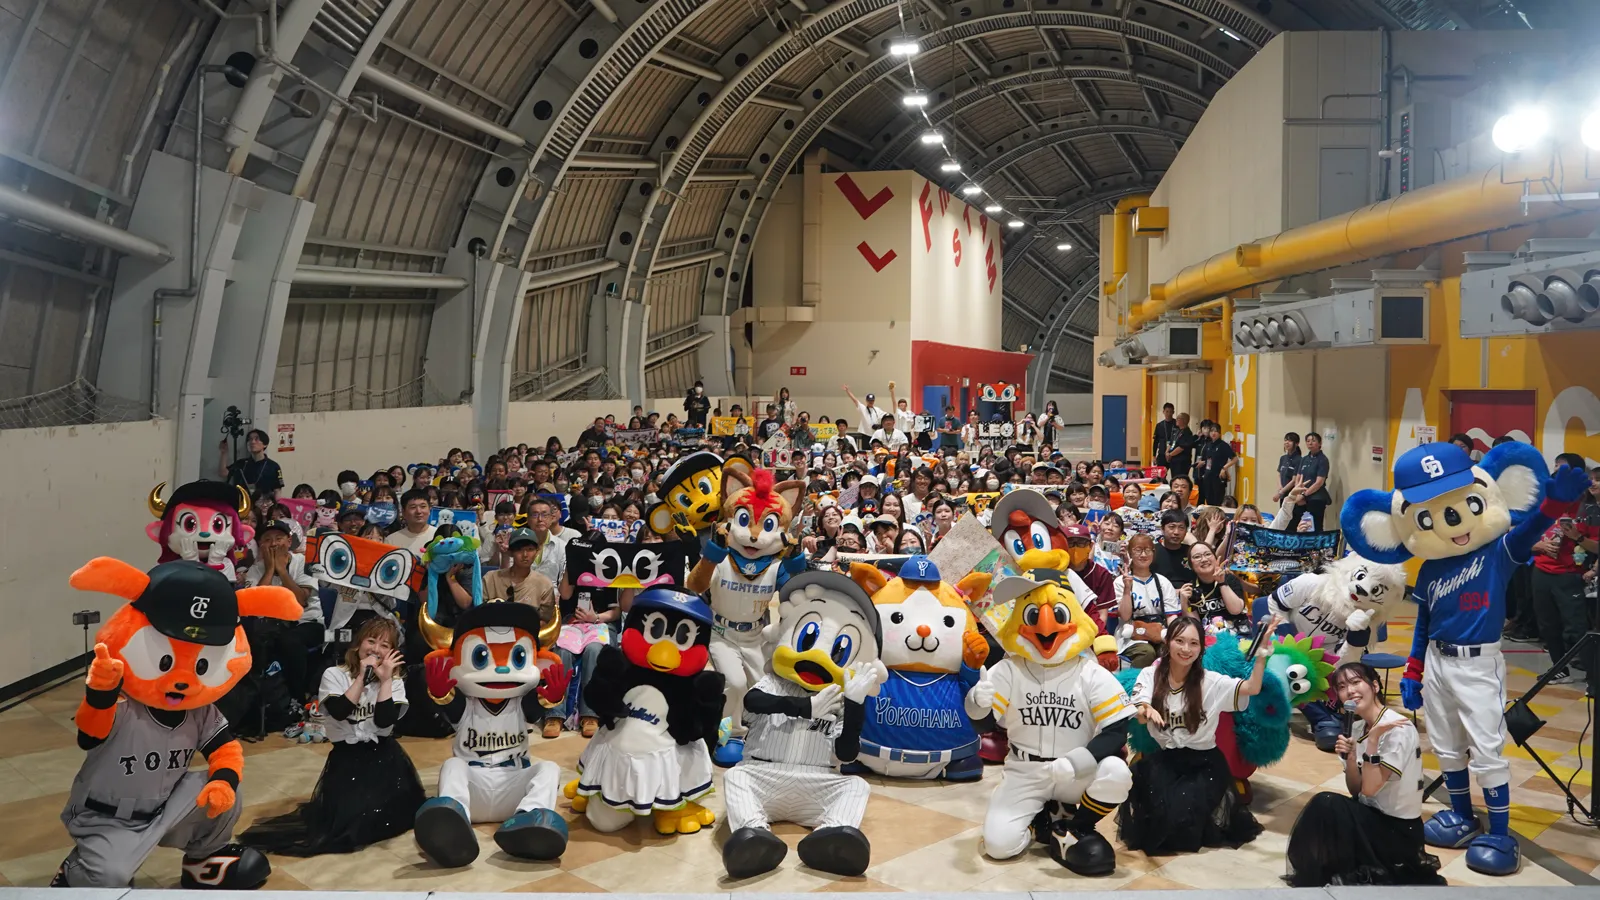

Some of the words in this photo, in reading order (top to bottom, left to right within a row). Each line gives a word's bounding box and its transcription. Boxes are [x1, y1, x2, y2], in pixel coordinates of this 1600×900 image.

[368, 506, 395, 519] ドアラ
[720, 579, 773, 594] FIGHTERS
[1025, 690, 1076, 708] SoftBank
[875, 696, 962, 729] YOKOHAMA
[1018, 705, 1084, 730] HAWKS
